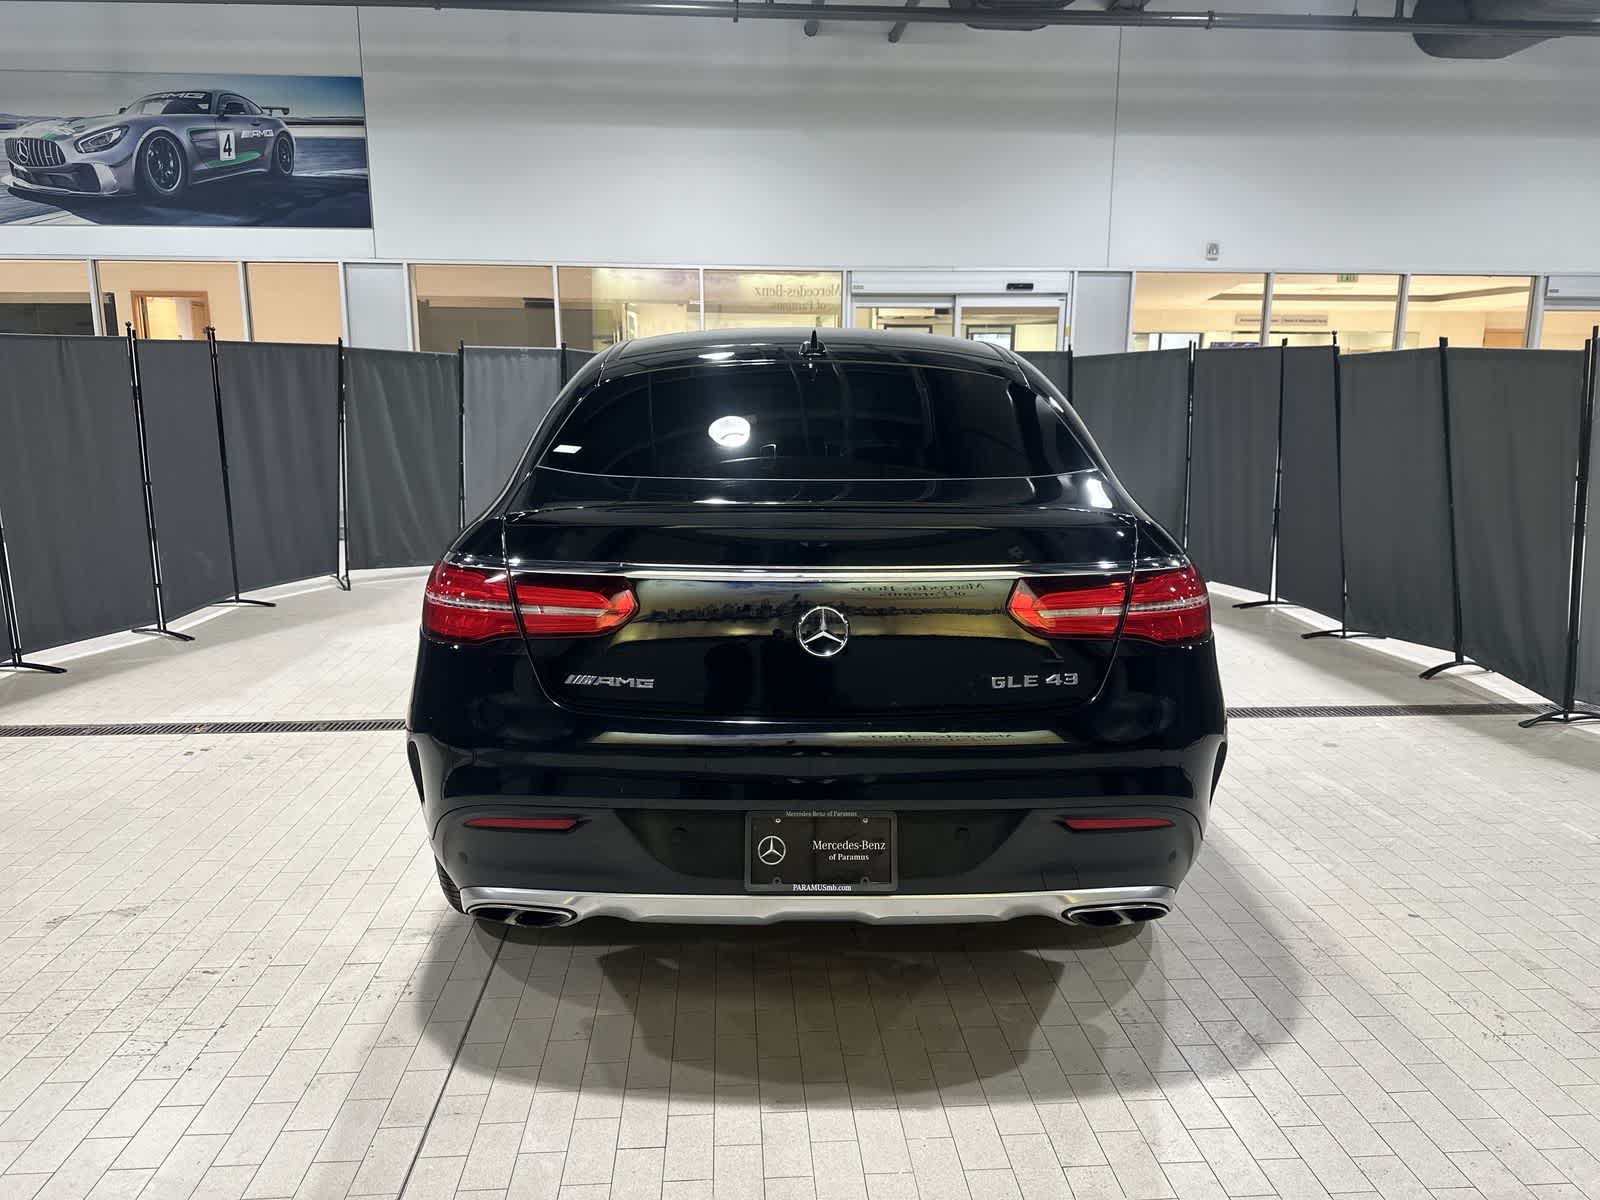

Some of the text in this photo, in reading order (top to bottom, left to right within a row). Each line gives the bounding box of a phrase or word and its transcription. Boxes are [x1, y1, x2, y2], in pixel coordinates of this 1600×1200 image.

[223, 133, 233, 157] 4
[591, 675, 655, 688] AMG
[991, 672, 1079, 689] GLE 43
[812, 840, 886, 851] Mercedes-Benz
[828, 853, 870, 861] of Paramus
[792, 884, 852, 892] PARAMUSmb.com
